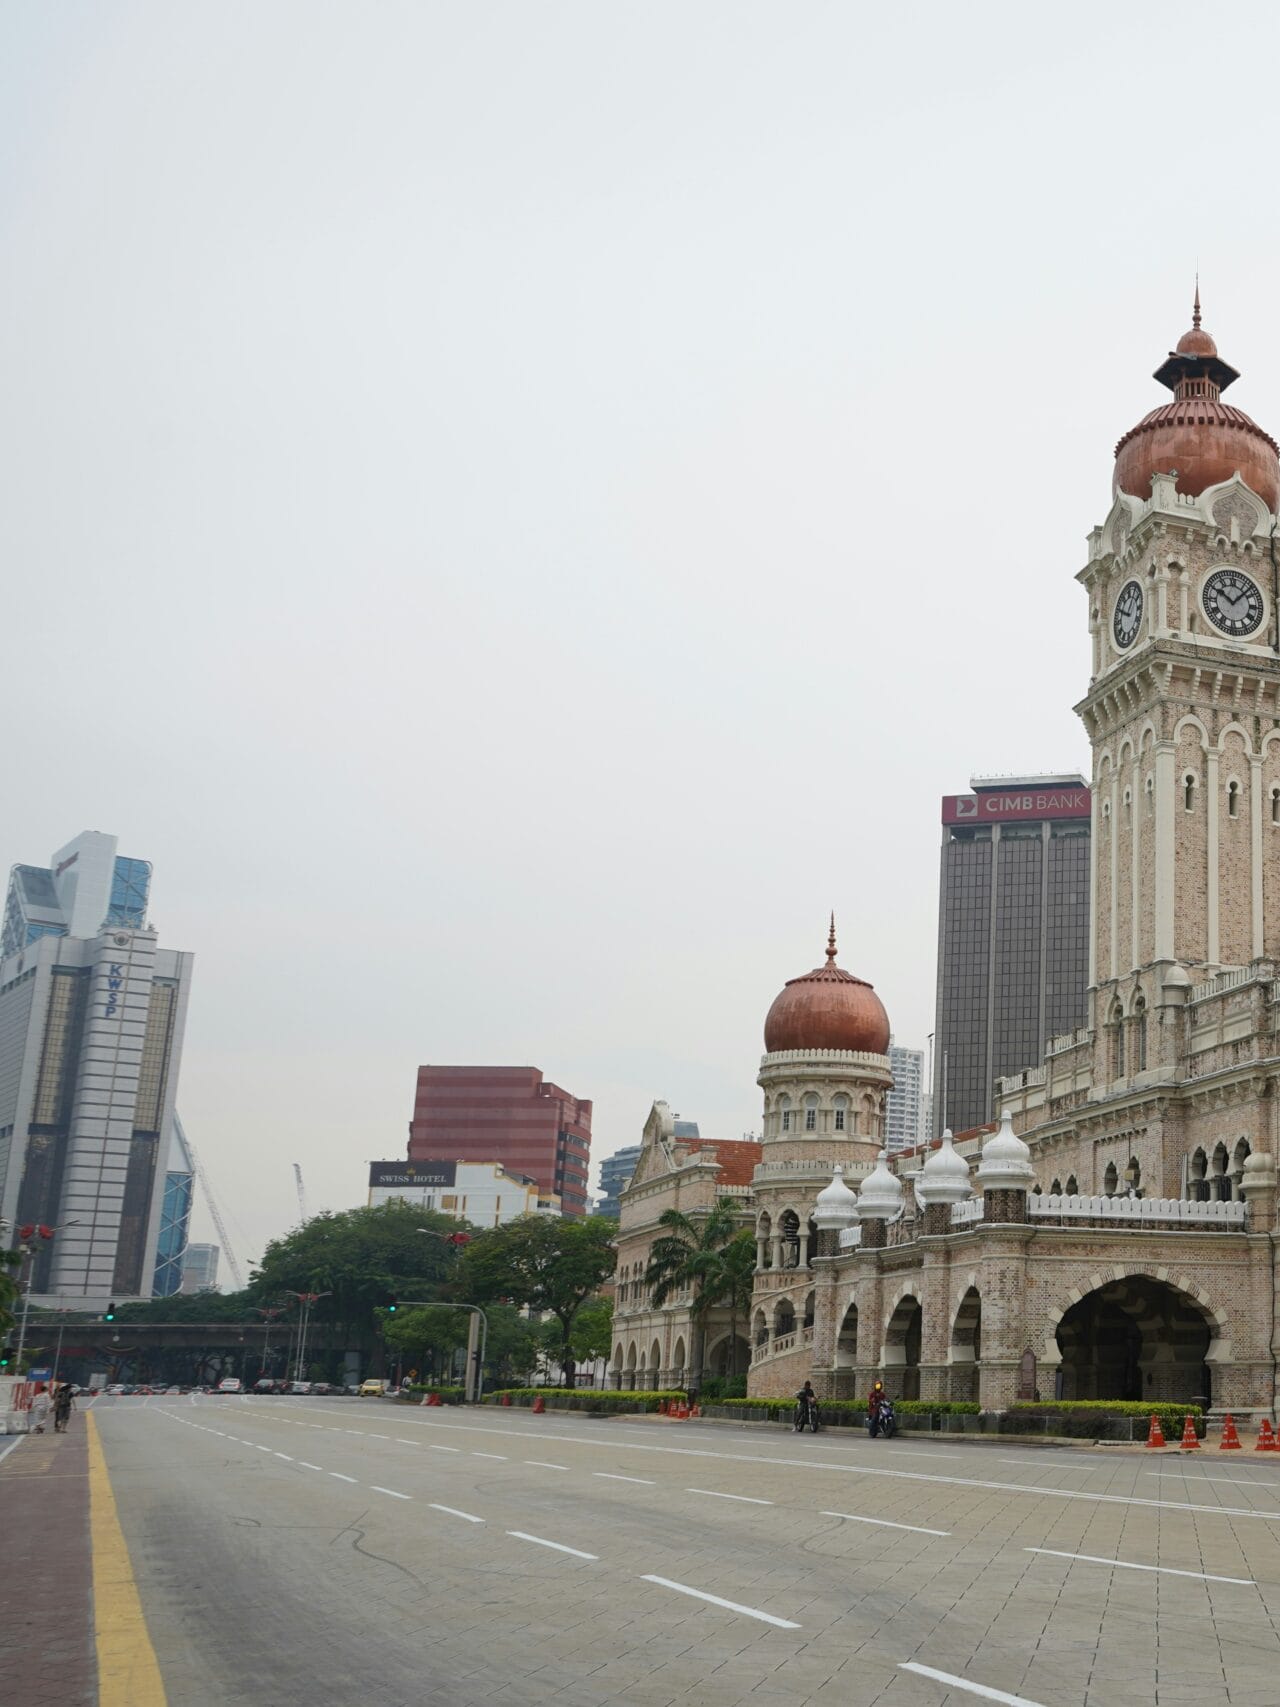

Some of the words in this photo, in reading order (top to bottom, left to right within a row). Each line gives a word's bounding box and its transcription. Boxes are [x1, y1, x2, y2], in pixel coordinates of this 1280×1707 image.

[986, 796, 1033, 812] CIMB
[1036, 794, 1085, 810] BANK
[105, 964, 123, 1017] KWSP
[379, 1175, 410, 1183] SWISS
[413, 1175, 447, 1183] HOTEL
